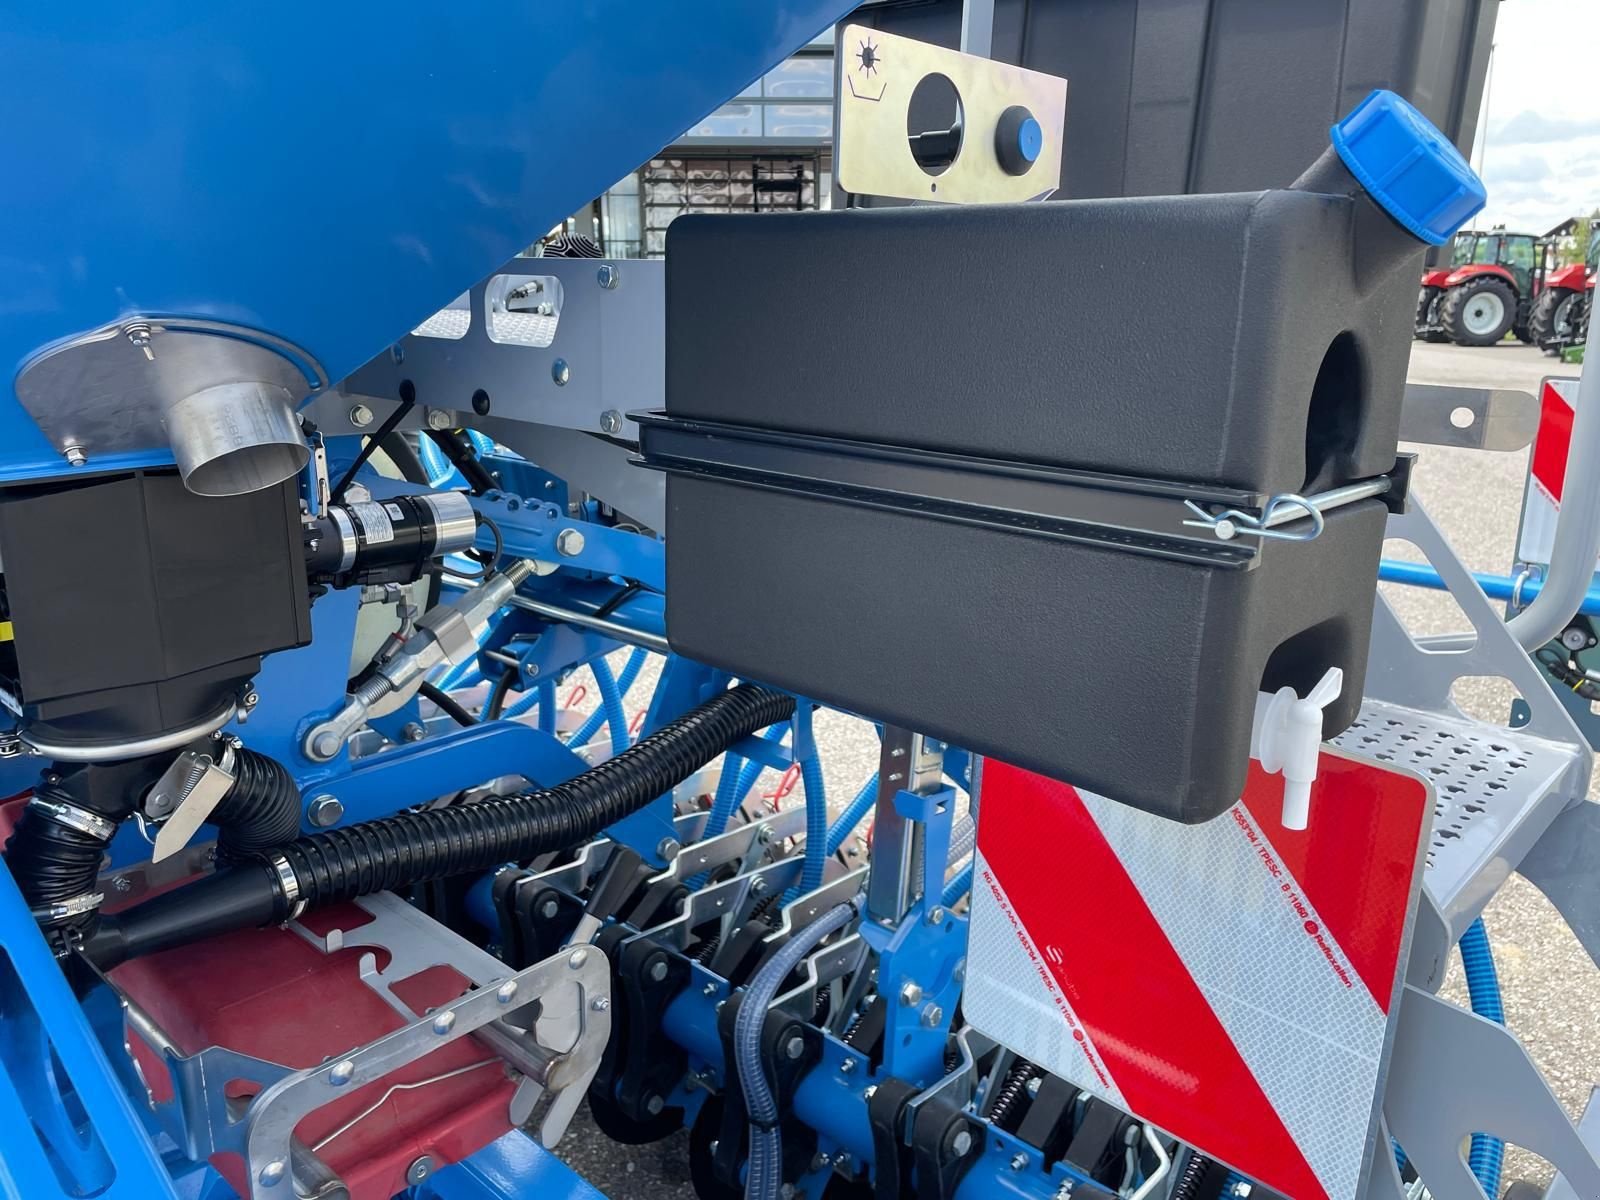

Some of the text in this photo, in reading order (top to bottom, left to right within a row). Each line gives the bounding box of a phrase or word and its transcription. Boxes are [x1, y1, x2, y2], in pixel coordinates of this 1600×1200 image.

[1257, 847, 1282, 878] TPESC
[1281, 882, 1289, 892] B
[1287, 892, 1308, 919] 11060
[1313, 933, 1353, 988] Reflexallen
[1037, 966, 1055, 992] TPESC
